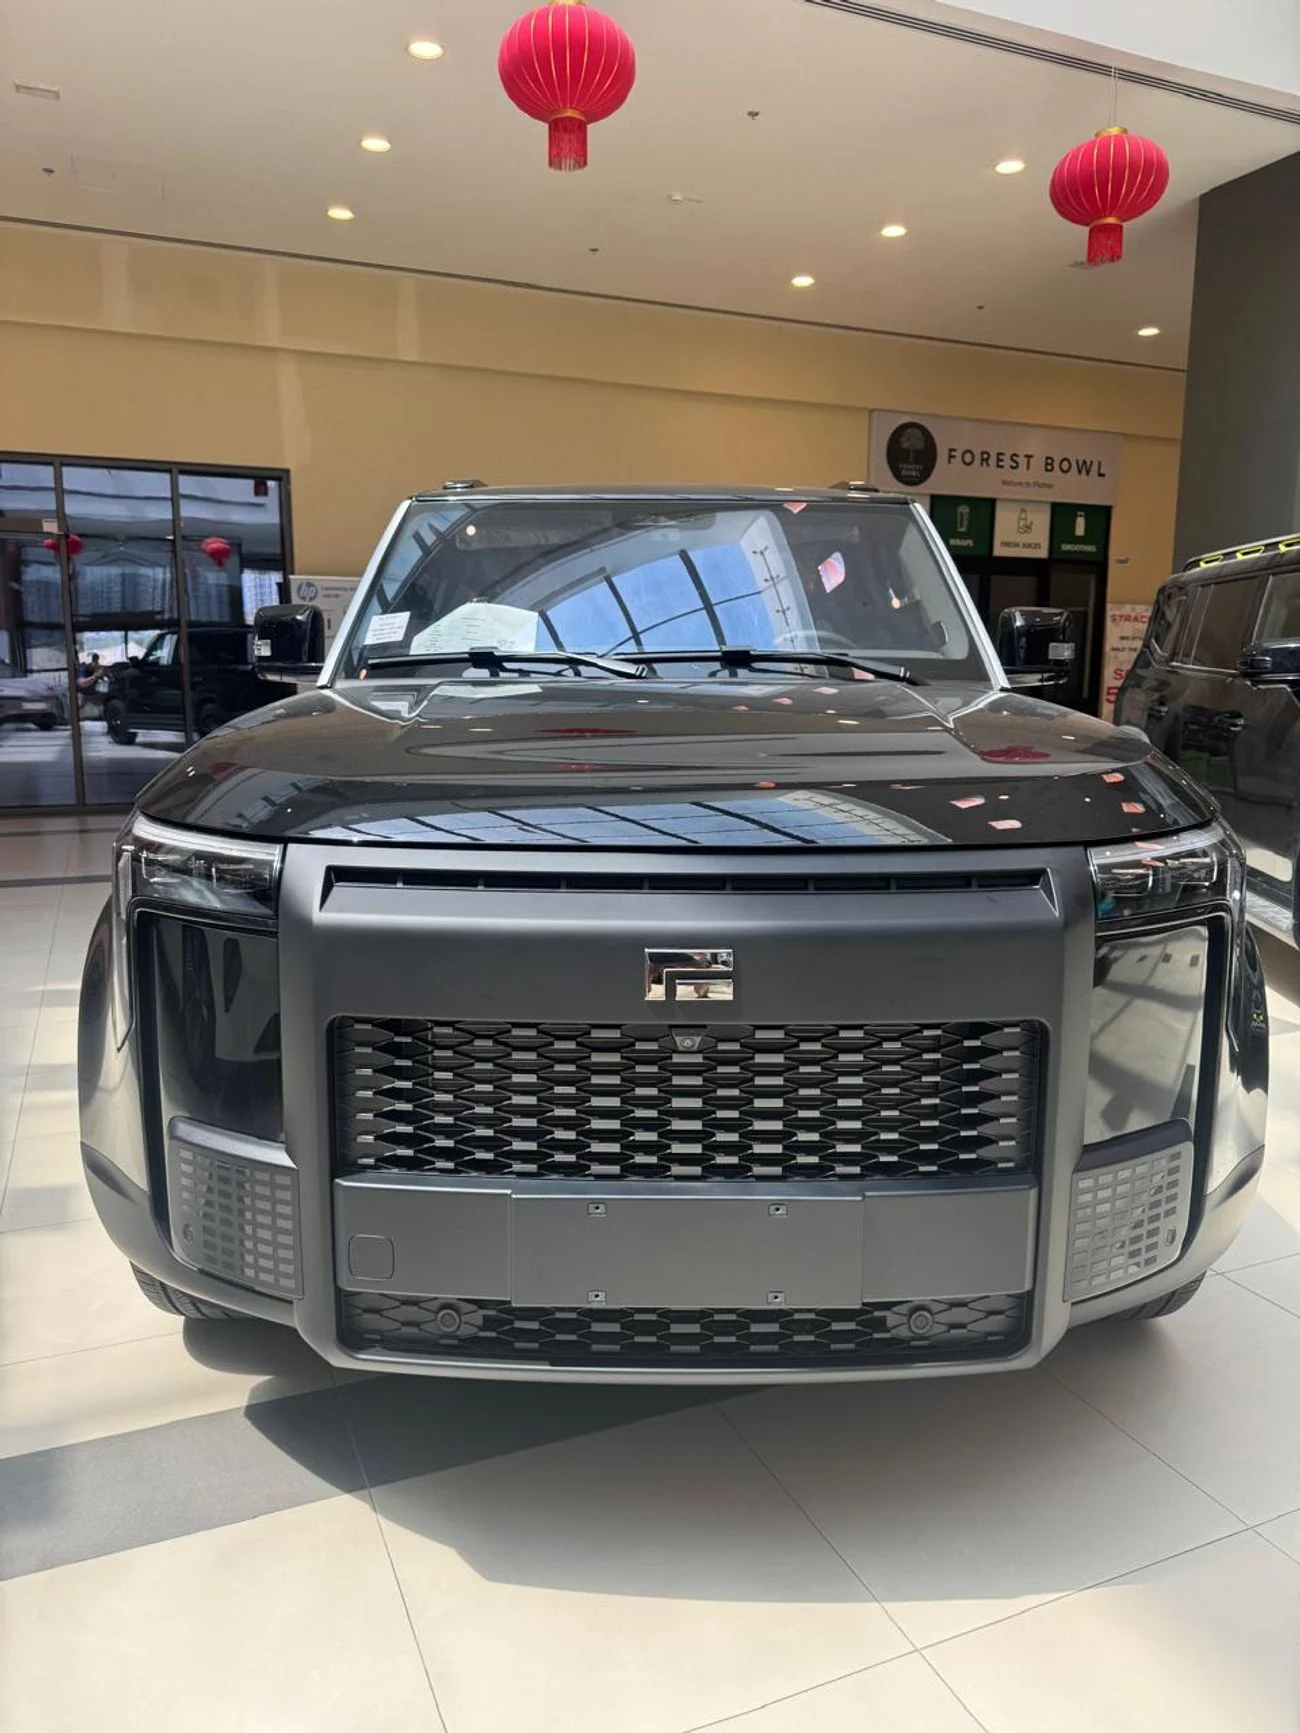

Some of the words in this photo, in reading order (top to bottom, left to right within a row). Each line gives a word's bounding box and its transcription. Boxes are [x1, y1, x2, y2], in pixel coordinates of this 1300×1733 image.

[947, 448, 1034, 471] FOREST
[1044, 456, 1107, 478] BOWL
[300, 582, 316, 602] hp
[1110, 613, 1150, 624] STRAC
